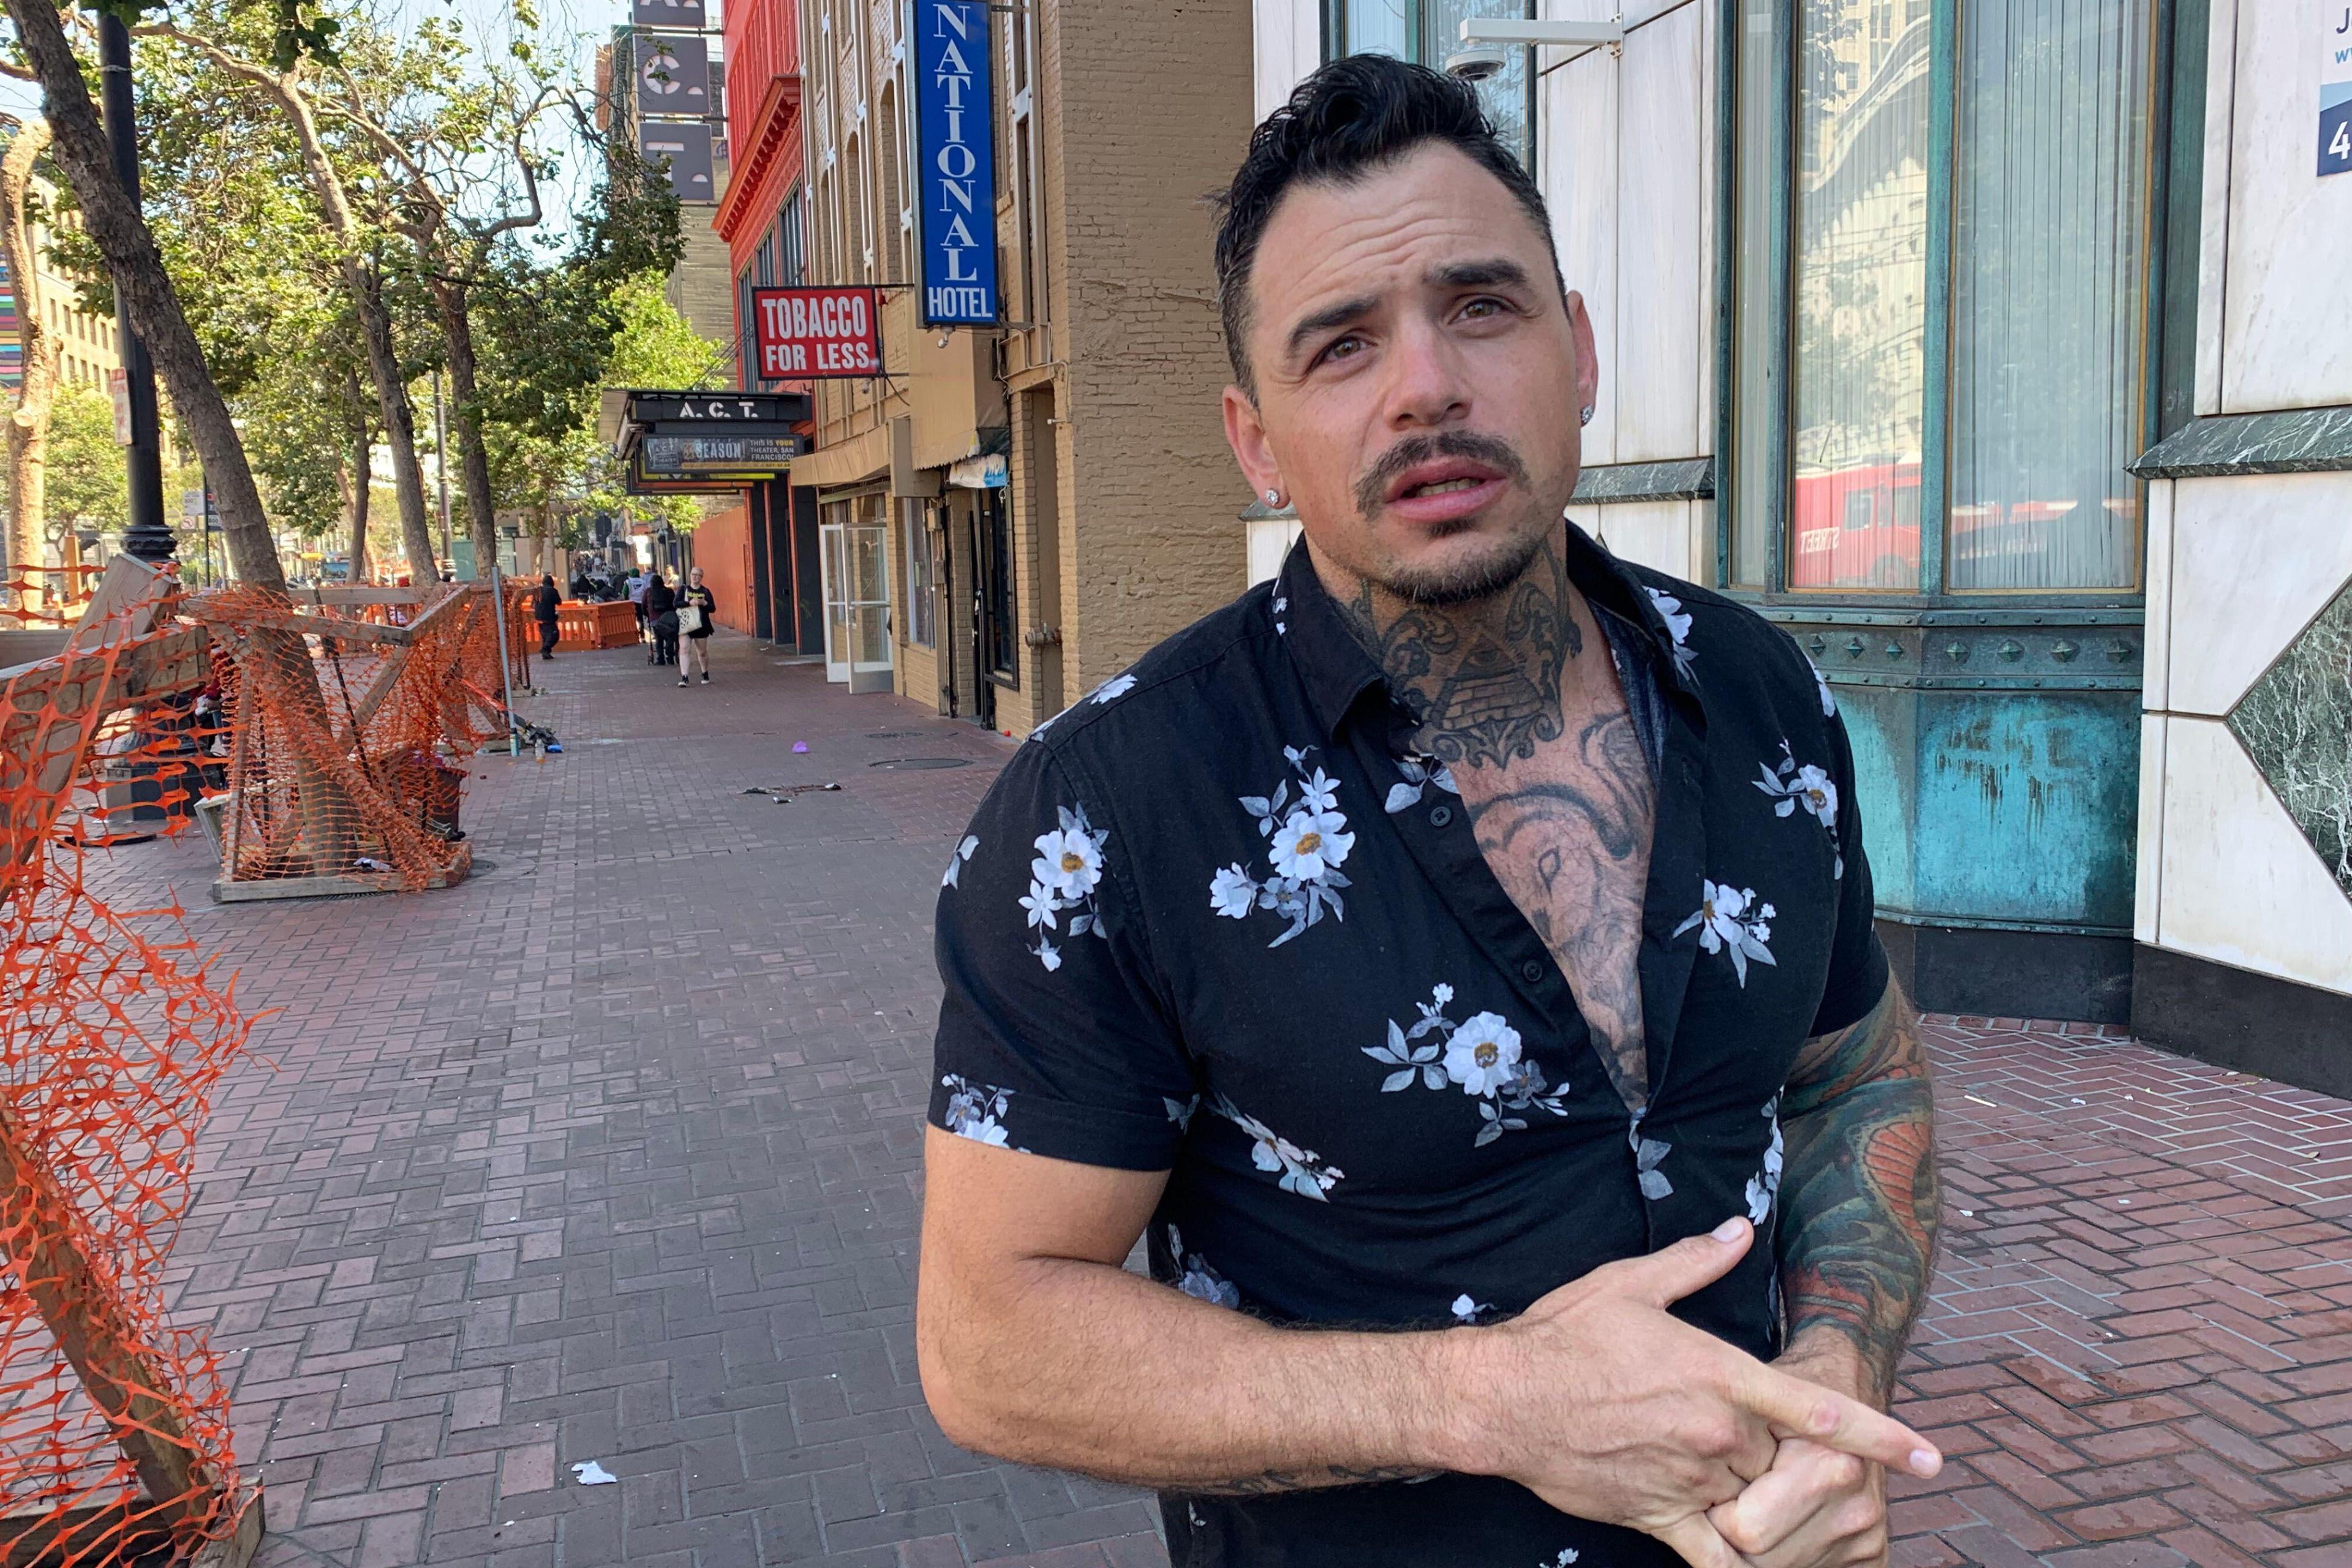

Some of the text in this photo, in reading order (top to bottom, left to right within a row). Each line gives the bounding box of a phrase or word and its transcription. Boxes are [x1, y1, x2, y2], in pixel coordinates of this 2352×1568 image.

[2335, 7, 2352, 34] J
[933, 4, 979, 281] NATIONAL
[928, 287, 993, 317] HOTEL
[761, 296, 867, 339] TOBACCO
[766, 342, 869, 371] FOR LESS
